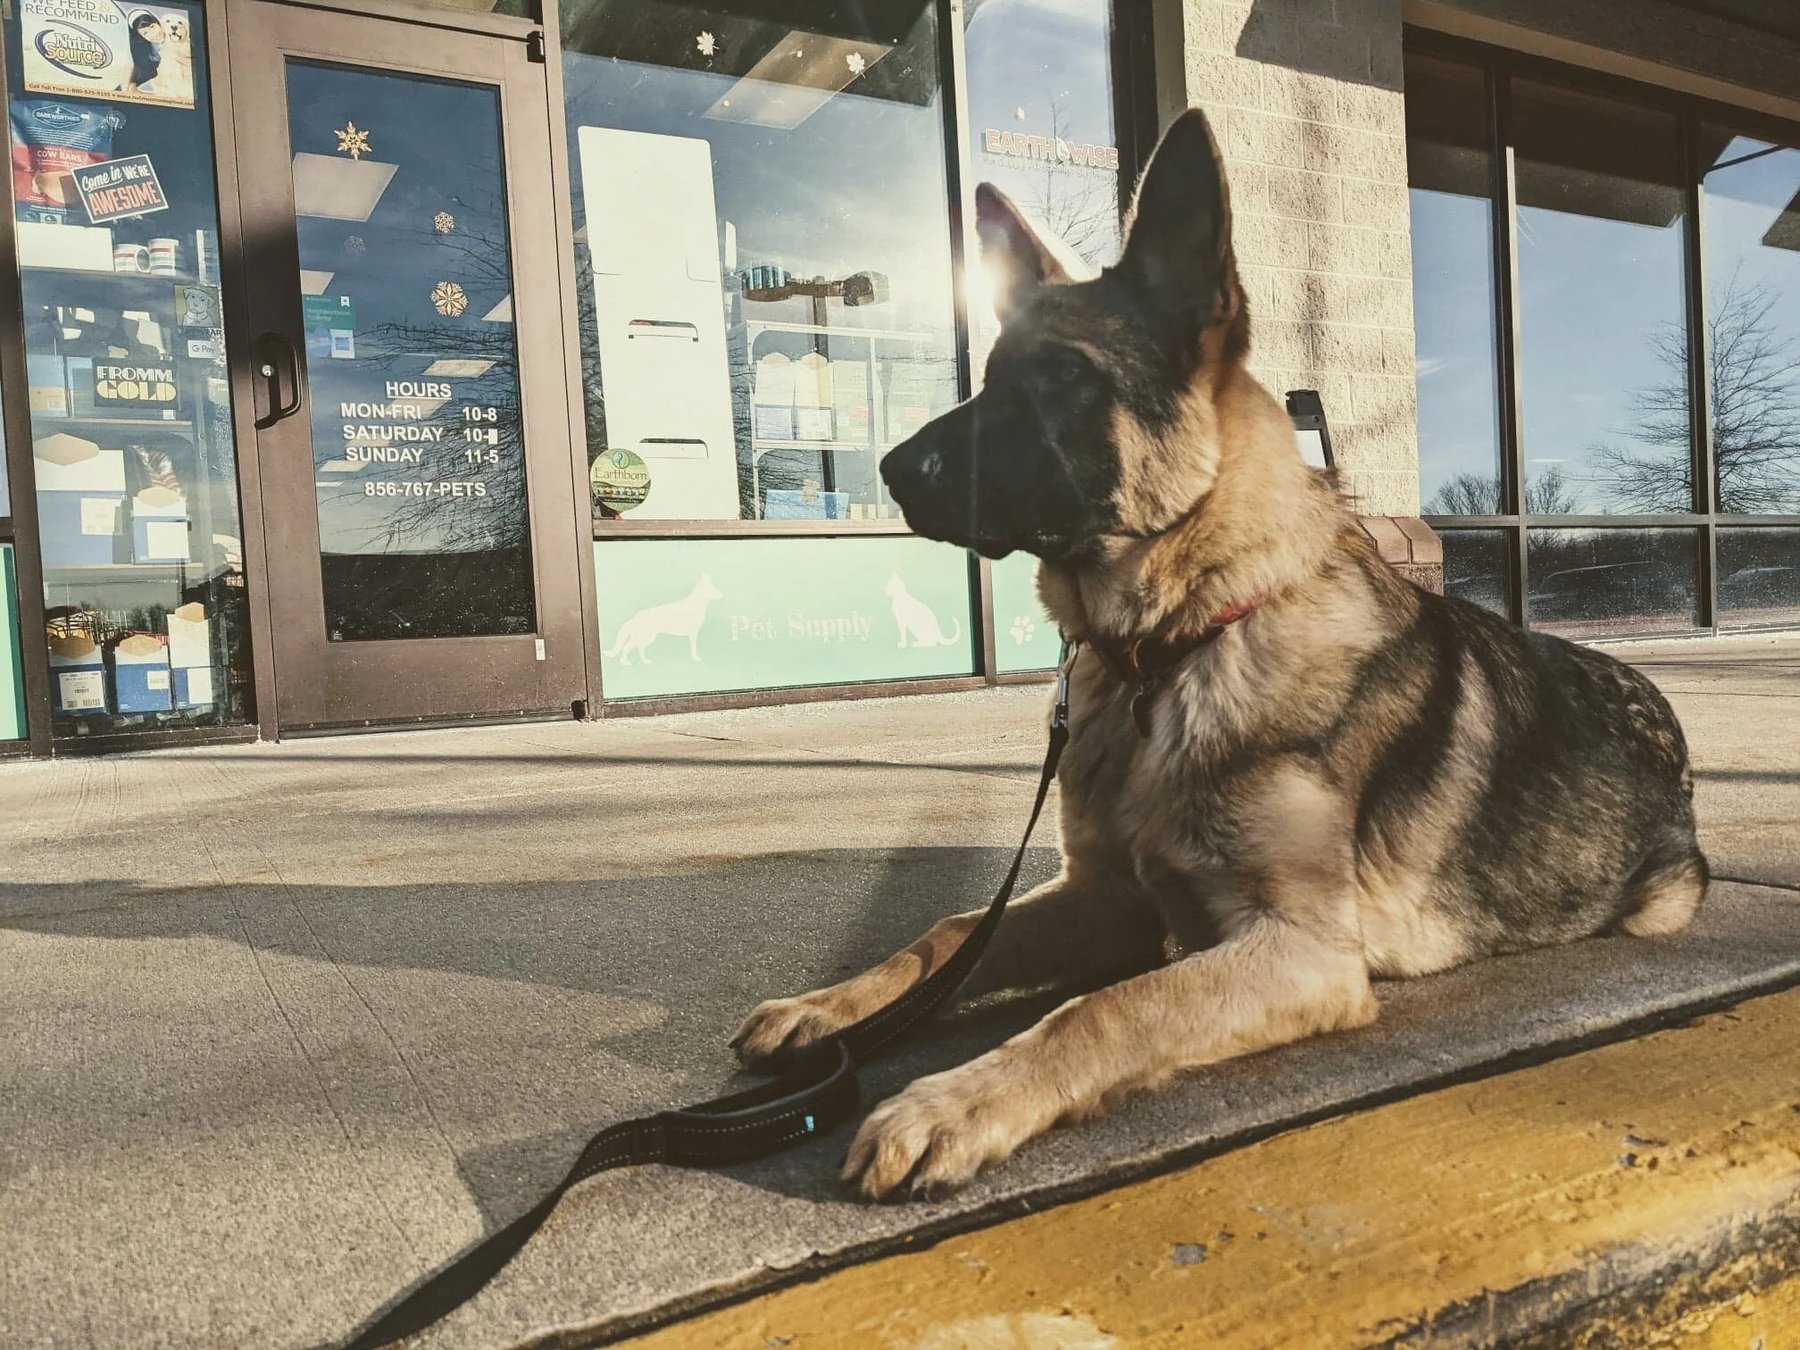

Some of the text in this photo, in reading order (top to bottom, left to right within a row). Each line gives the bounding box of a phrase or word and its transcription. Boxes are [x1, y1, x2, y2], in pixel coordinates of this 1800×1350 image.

[25, 4, 119, 25] RECOMMEND
[60, 0, 95, 11] FEED
[45, 42, 106, 64] Source
[37, 150, 82, 162] COW EARS
[82, 172, 110, 192] Come
[110, 166, 122, 181] in
[88, 181, 162, 217] AWESOME
[96, 365, 174, 383] FROMM
[96, 380, 177, 402] GOLD
[385, 381, 452, 398] HOURS
[340, 402, 498, 422] MON-FRI 10-8
[343, 424, 498, 445] SATURDAY 10-
[345, 446, 499, 464] SUNDAY 11-5
[594, 466, 648, 481] Earthborn
[364, 480, 487, 498] 856-767-PETS
[729, 610, 872, 644] Pet Supply
